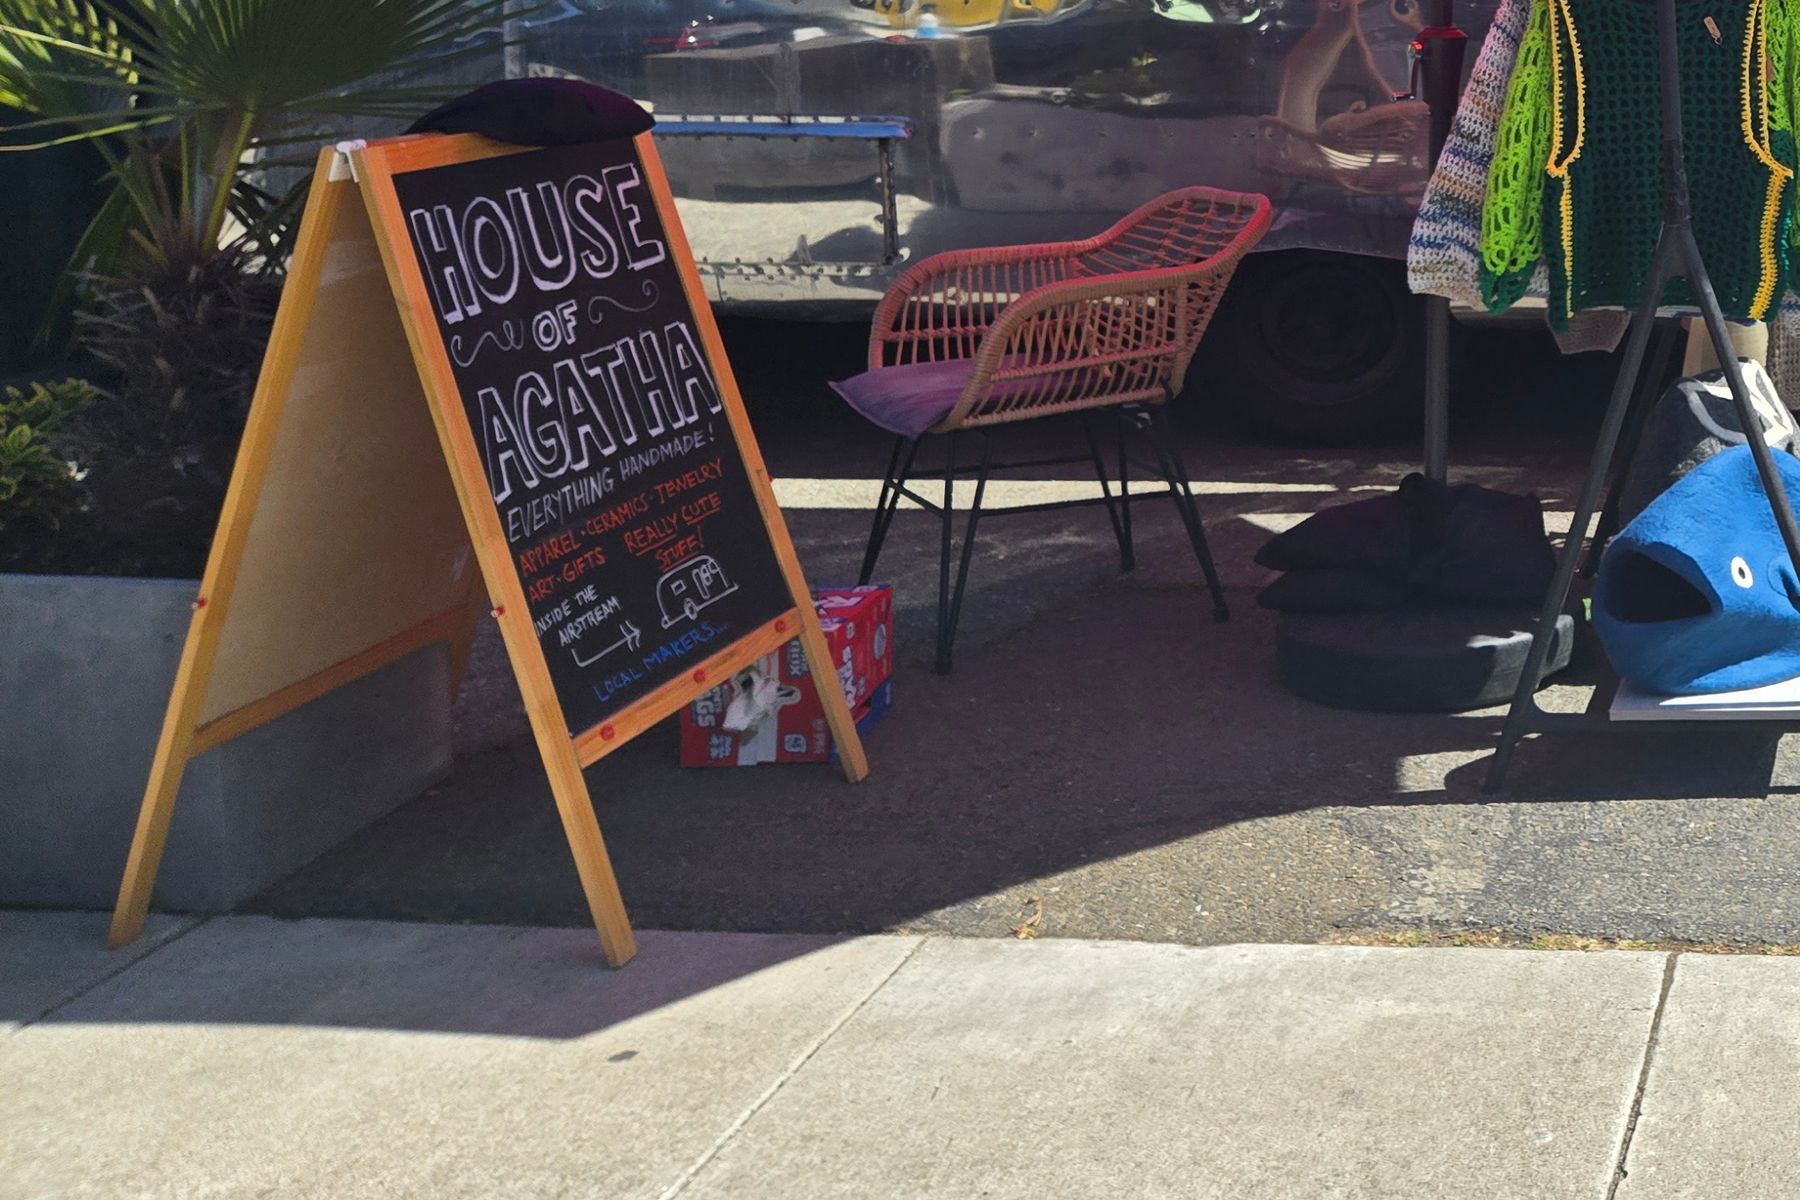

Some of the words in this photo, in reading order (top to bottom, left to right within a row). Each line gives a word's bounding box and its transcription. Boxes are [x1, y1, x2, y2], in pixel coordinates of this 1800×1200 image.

[411, 162, 666, 324] HOUSE
[531, 300, 581, 351] OF
[476, 321, 722, 505] AGATHA
[508, 466, 616, 543] EVERYTHING
[618, 423, 716, 481] HANDMADE!
[519, 528, 583, 578] APPAREL
[586, 493, 648, 536] CERAMICS
[655, 459, 723, 504] JEWELRY
[624, 512, 681, 553] REALLY
[681, 492, 722, 522] CUTE
[655, 525, 705, 568] STUFF!
[535, 597, 573, 638] INSIDE
[573, 584, 600, 608] THE
[557, 595, 622, 647] AIRSTREAM
[592, 664, 642, 703] LOCAL
